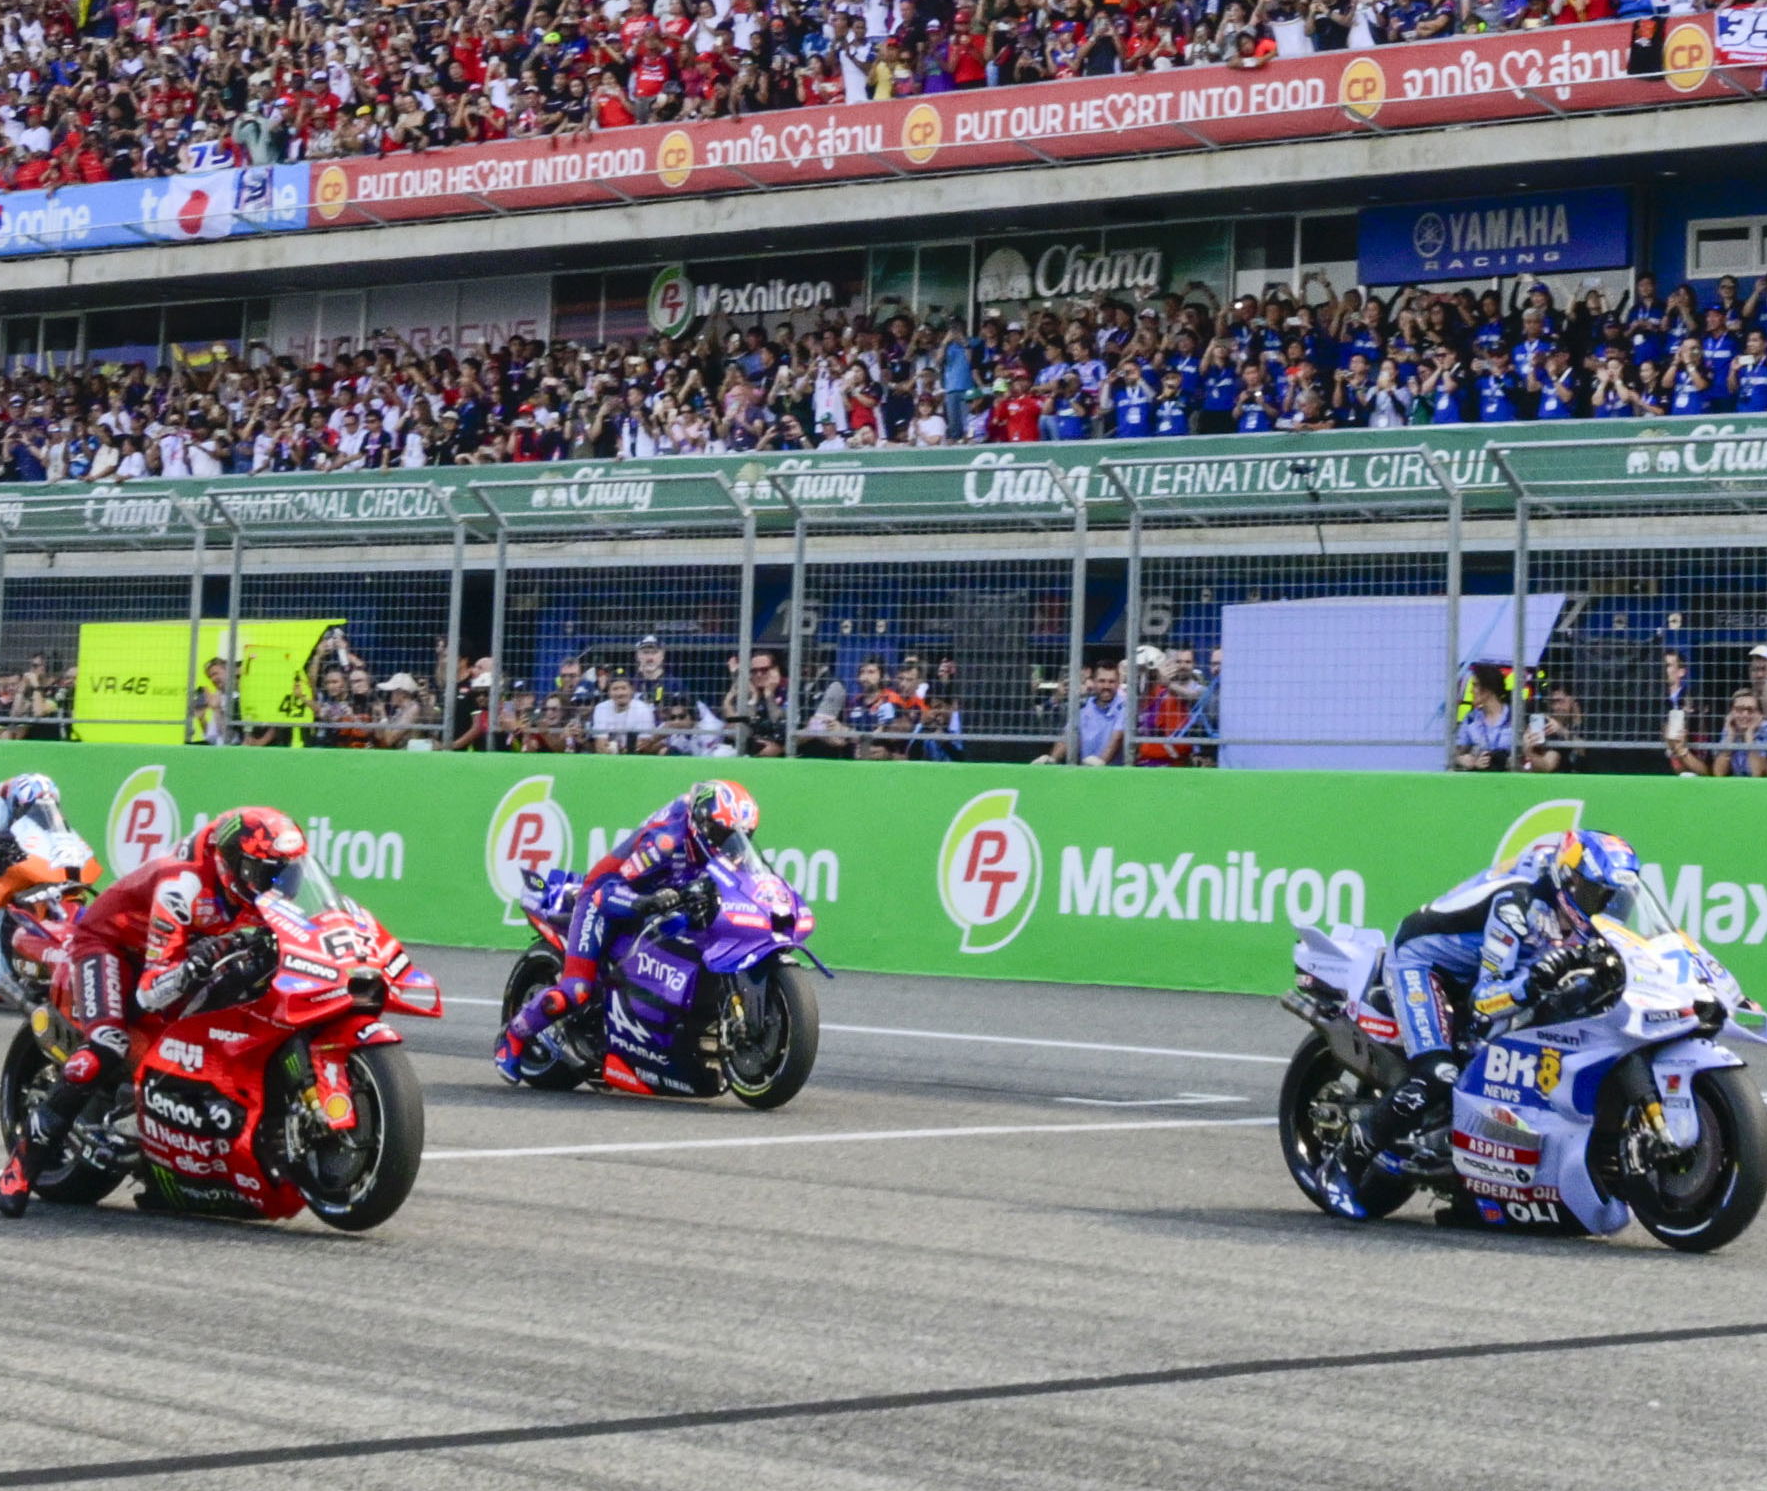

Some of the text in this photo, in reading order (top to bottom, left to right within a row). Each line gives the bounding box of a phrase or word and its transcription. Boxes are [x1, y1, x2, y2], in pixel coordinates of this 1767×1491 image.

[1670, 45, 1703, 69] CP
[1347, 75, 1379, 103] CP
[1403, 49, 1495, 100] จากใจ
[956, 108, 1005, 142] PUT
[1011, 101, 1063, 138] OUR
[1179, 86, 1241, 121] INTO
[1249, 78, 1325, 114] FOOD
[908, 120, 936, 145] CP
[357, 171, 396, 201] PUT
[400, 166, 441, 197] OUR
[532, 152, 583, 185] INTO
[587, 147, 644, 180] FOOD
[665, 147, 688, 172] CP
[1449, 206, 1570, 252] YAMAHA
[1035, 245, 1161, 302] Chang
[1424, 251, 1561, 271] RACING
[696, 280, 832, 318] Maxnitron
[125, 800, 163, 862] PT
[965, 830, 1017, 918] PT
[1059, 846, 1365, 927] Maxnitron
[285, 955, 338, 981] Lenovo
[82, 960, 98, 1019] Lenovo
[1536, 1030, 1581, 1047] DUCATI
[1483, 1083, 1521, 1103] NEWS
[1468, 1138, 1515, 1161] ASPIRA
[1465, 1177, 1560, 1202] FEDERAL OIL
